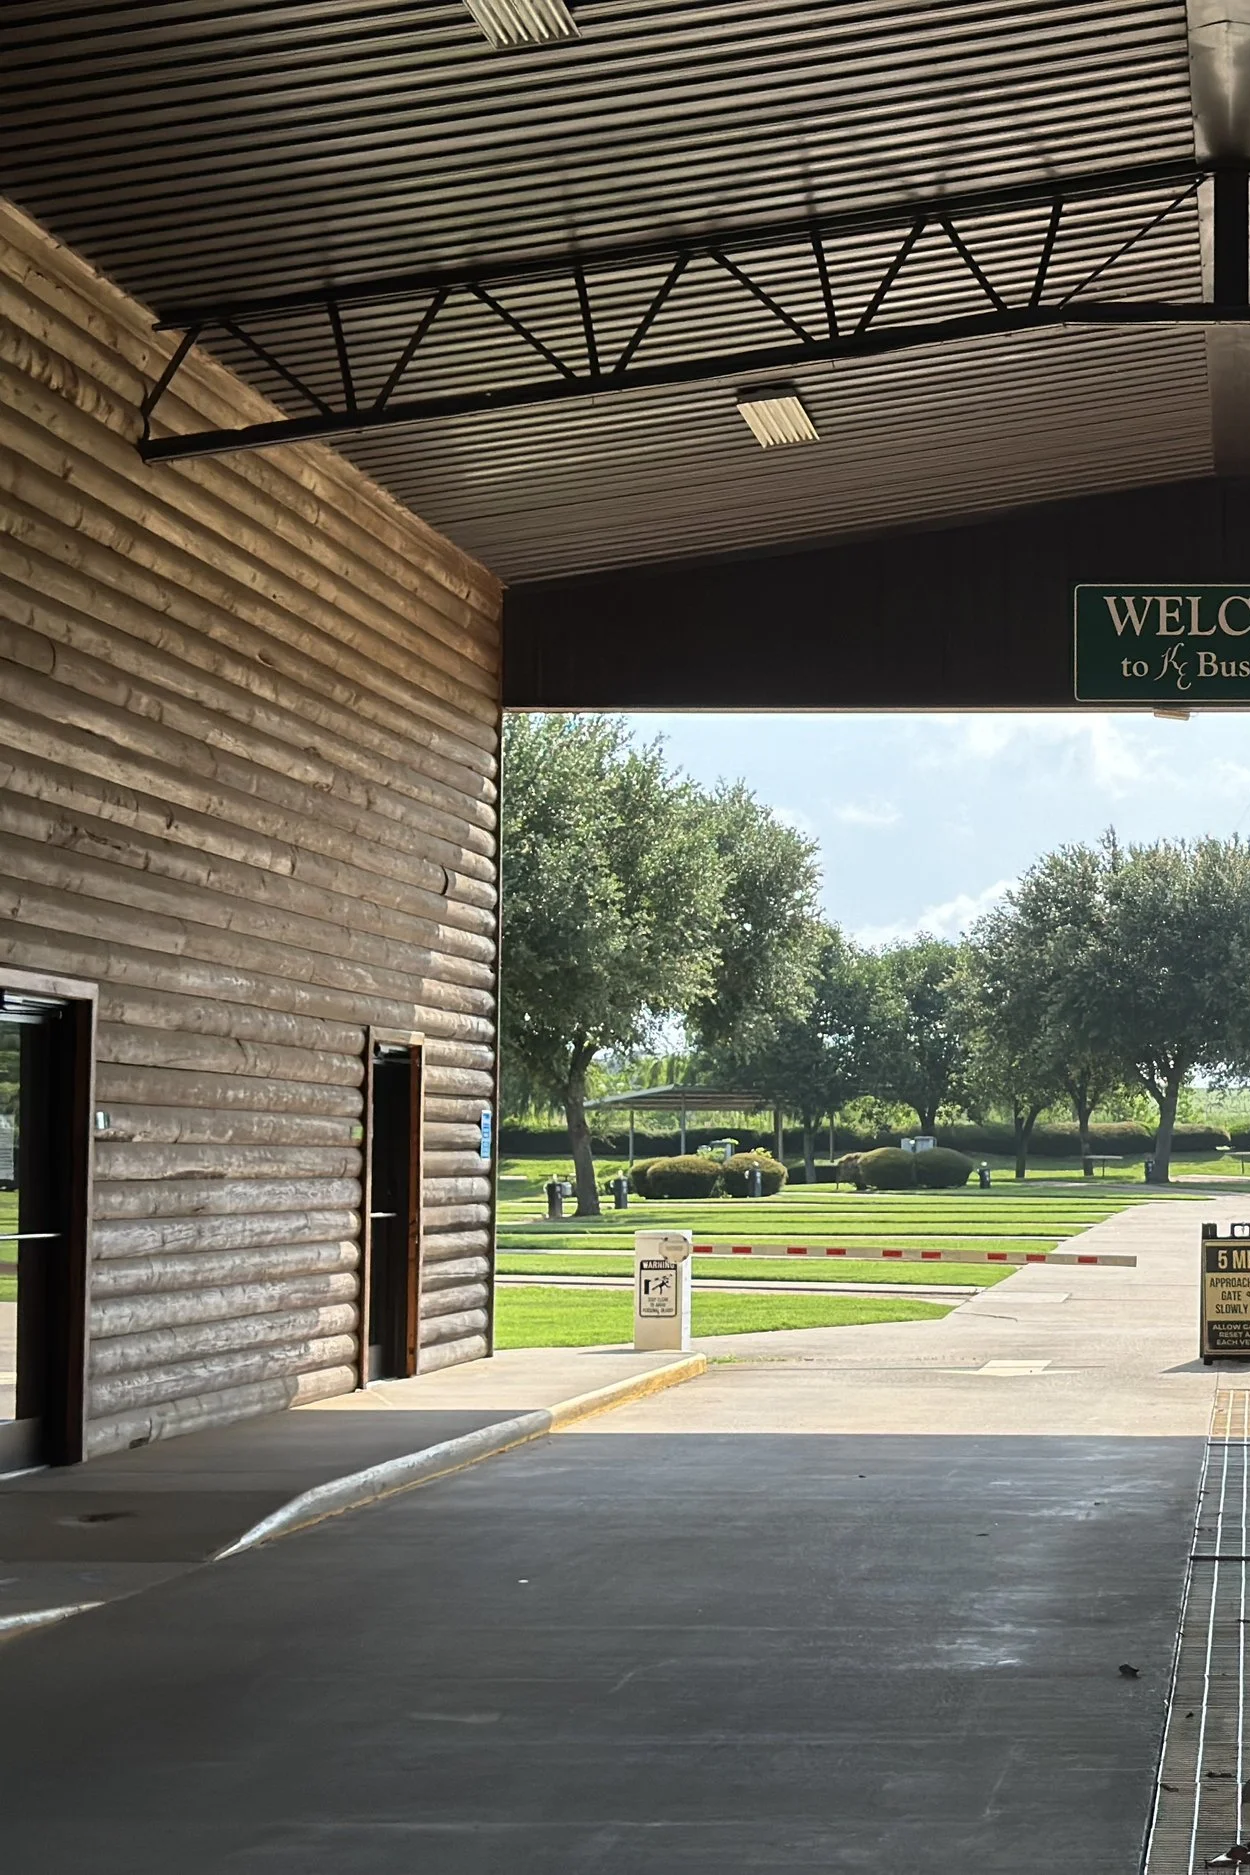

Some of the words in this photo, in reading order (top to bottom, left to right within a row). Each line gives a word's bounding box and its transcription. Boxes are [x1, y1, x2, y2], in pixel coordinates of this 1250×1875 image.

[1121, 656, 1149, 677] to
[1218, 1250, 1228, 1269] 5
[1221, 1290, 1242, 1301] GATE
[1215, 1303, 1249, 1314] SLOWLY
[1216, 1338, 1238, 1346] EACH
